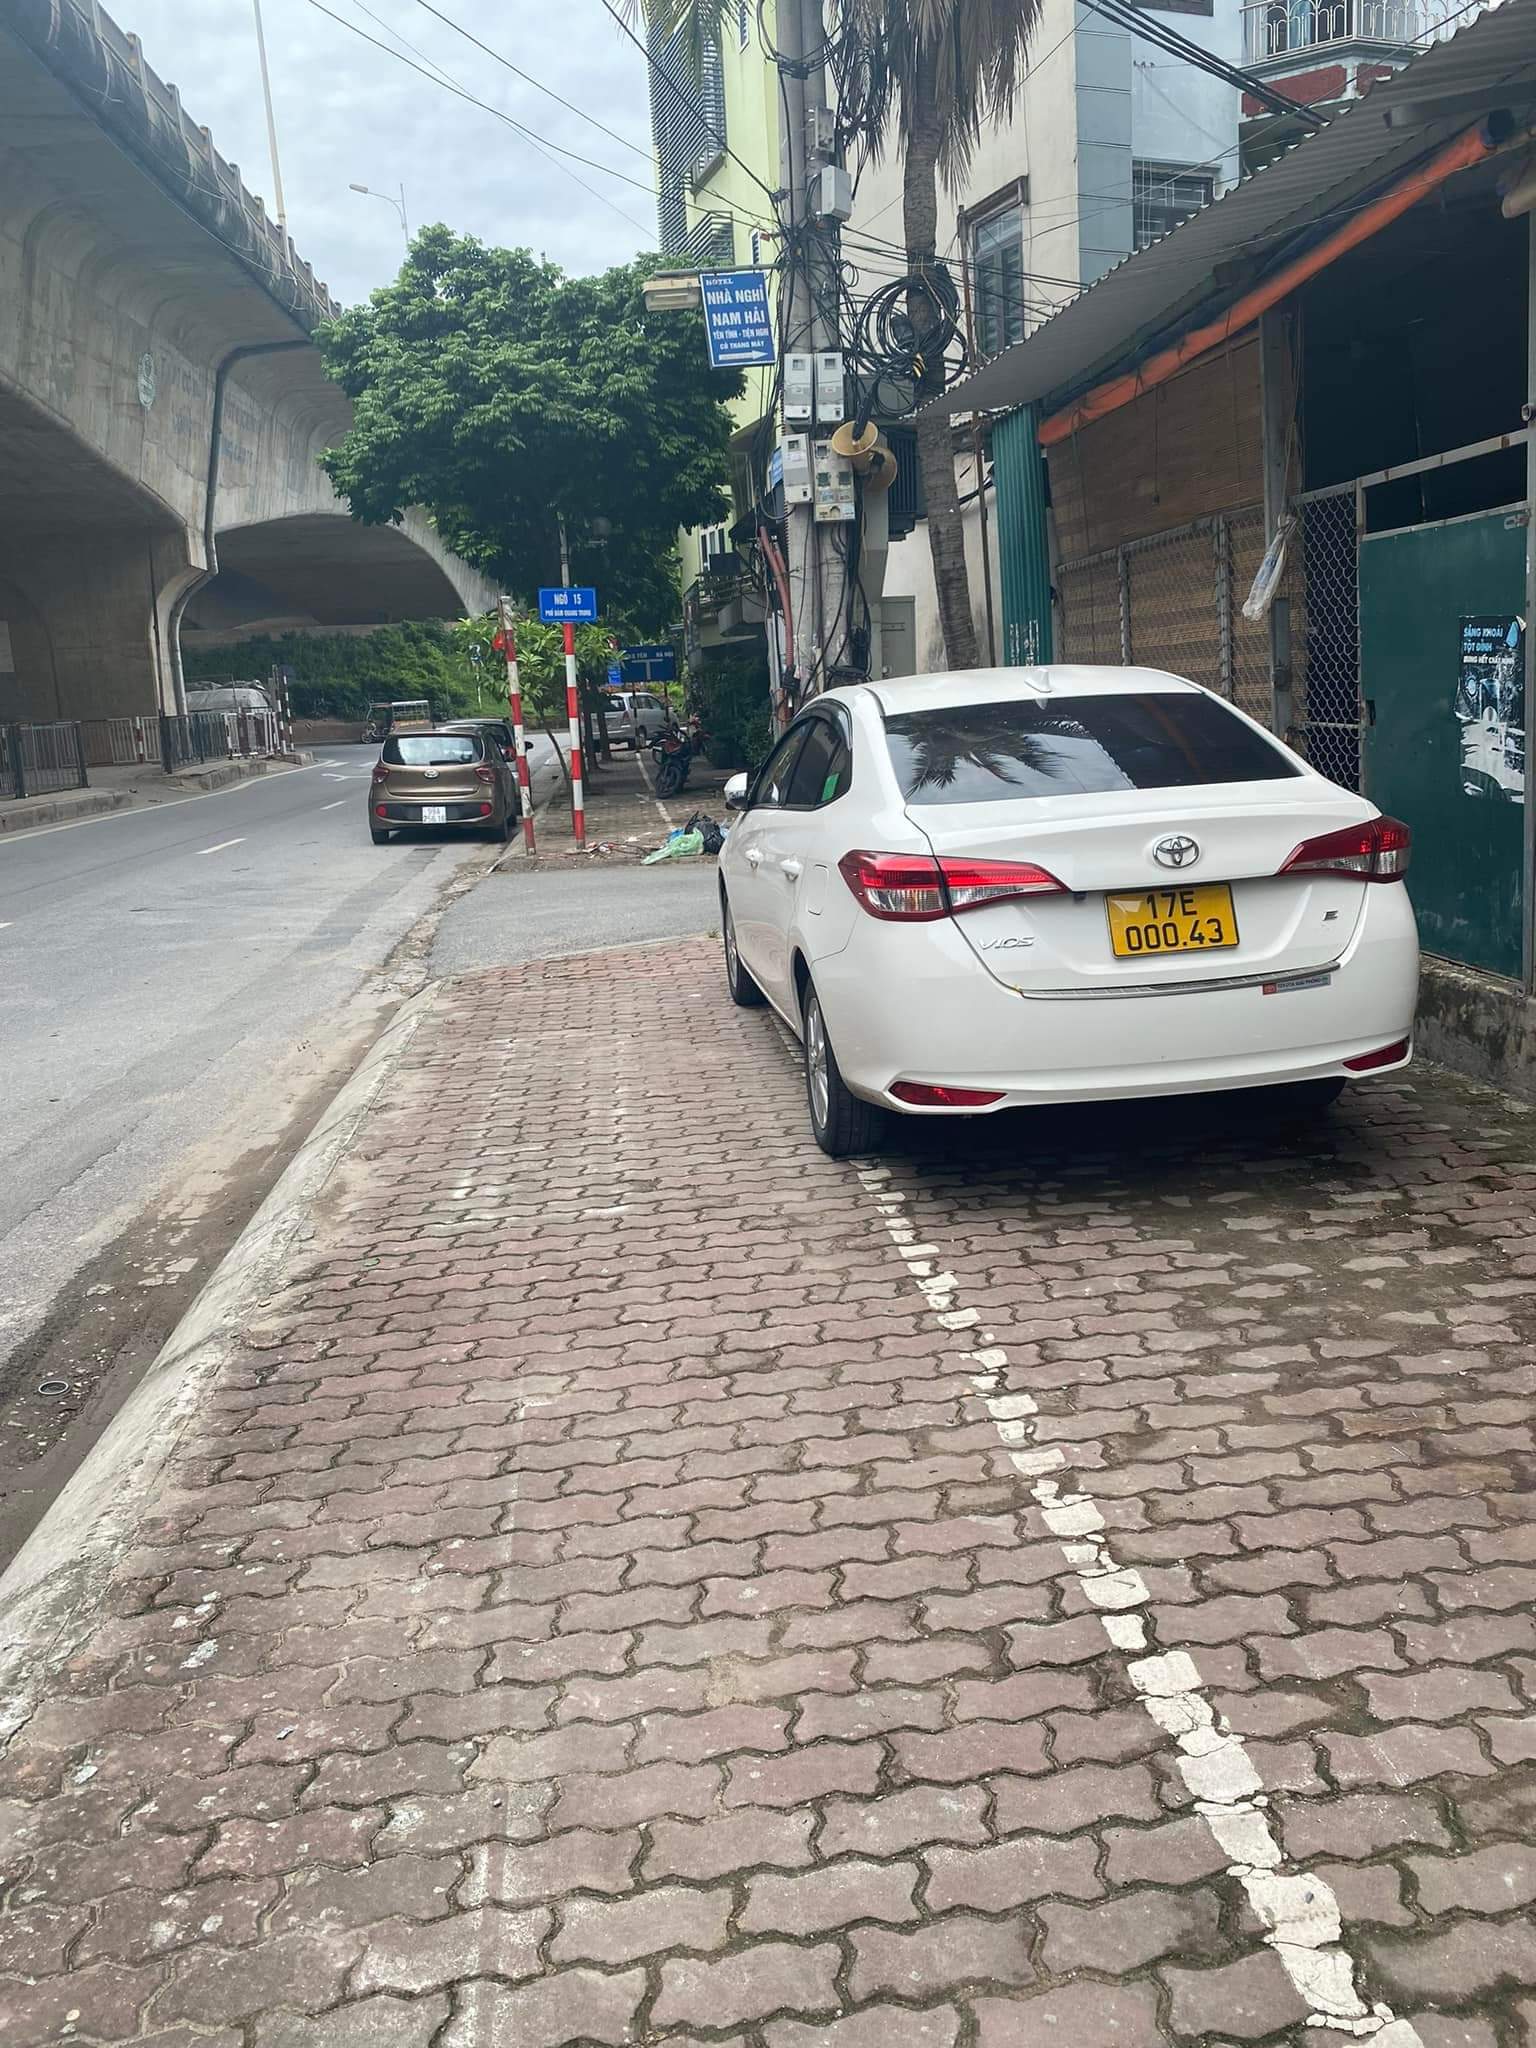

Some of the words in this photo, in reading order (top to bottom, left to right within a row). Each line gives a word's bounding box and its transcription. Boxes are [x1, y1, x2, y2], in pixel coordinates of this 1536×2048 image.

[706, 288, 733, 305] NHÀ
[734, 284, 764, 303] NGHỈ
[712, 311, 742, 326] NAM
[744, 306, 765, 324] HẢI
[573, 593, 582, 605] 15
[1146, 890, 1198, 919] 17E
[978, 936, 1036, 951] VIOS
[1125, 918, 1224, 951] 000.43
